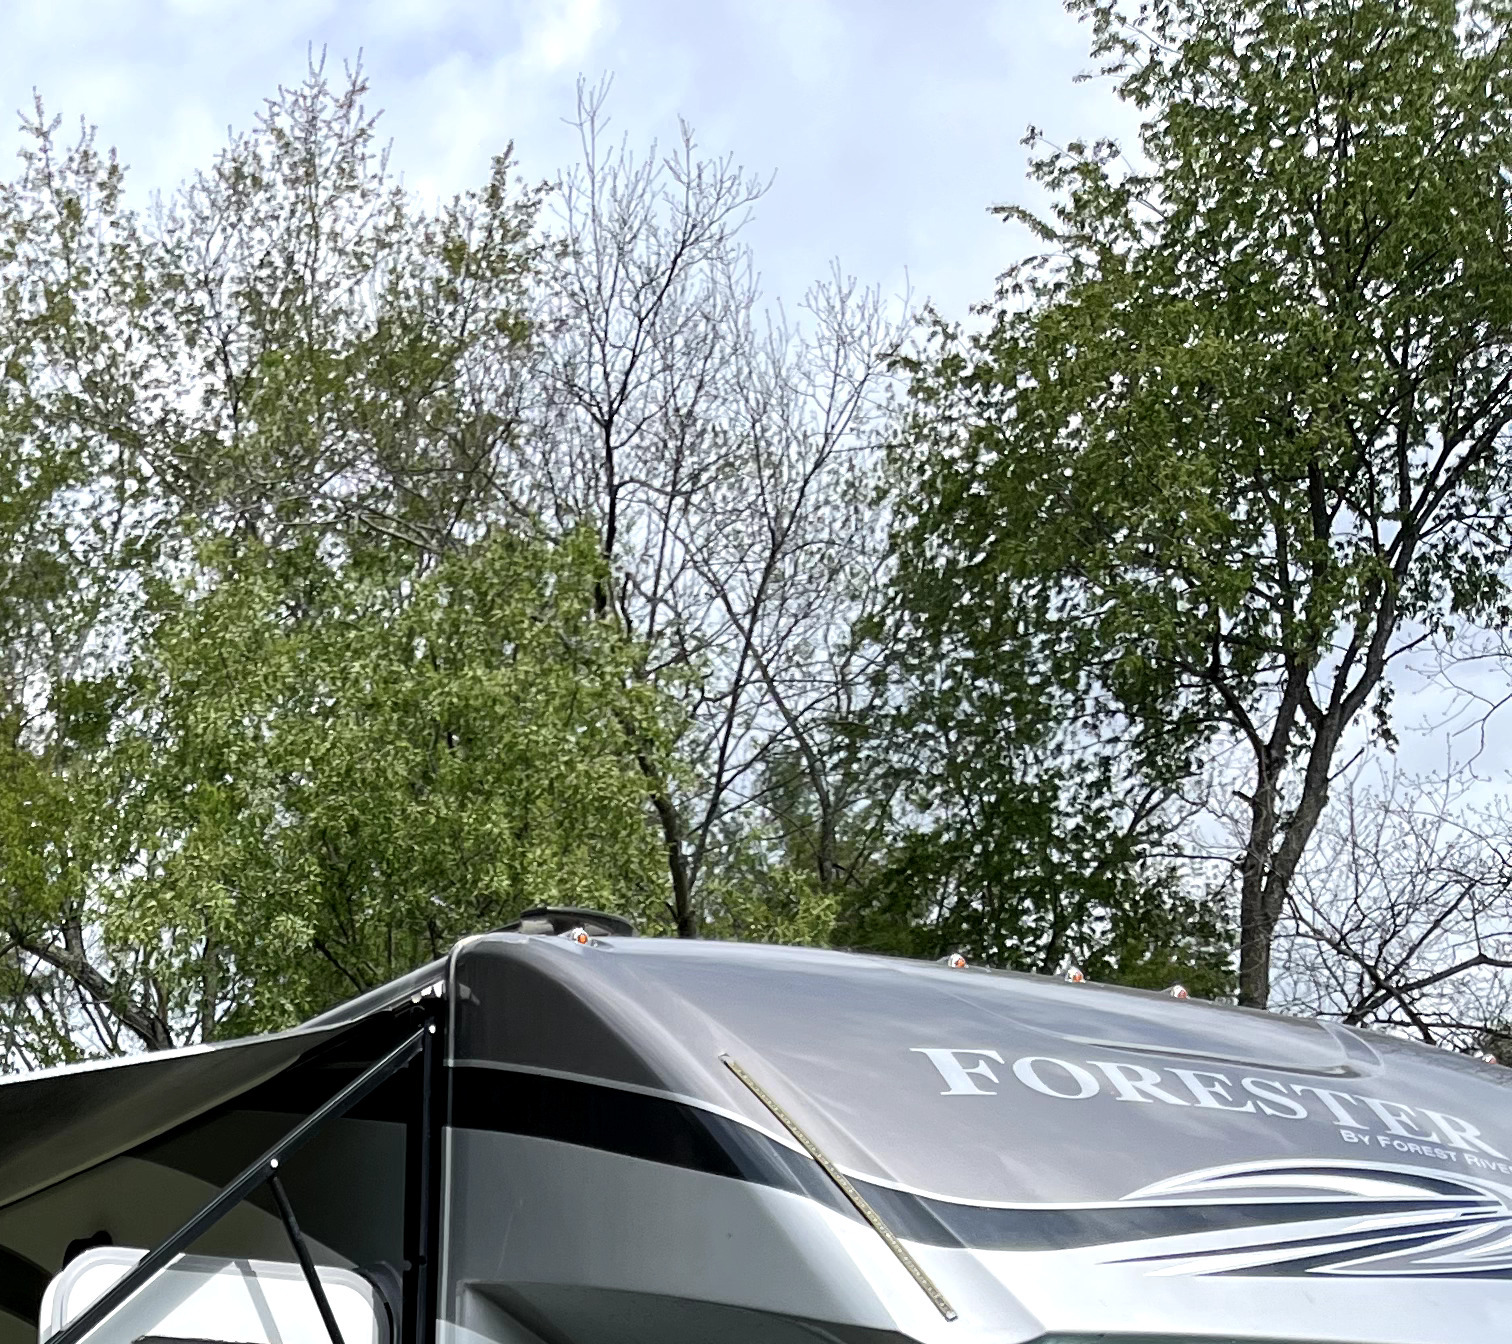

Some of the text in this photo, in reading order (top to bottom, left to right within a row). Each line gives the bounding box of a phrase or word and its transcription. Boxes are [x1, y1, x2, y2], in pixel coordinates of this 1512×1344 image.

[909, 1046, 1511, 1161] FORESTER
[1339, 1128, 1512, 1175] BY FOREST RIVE
